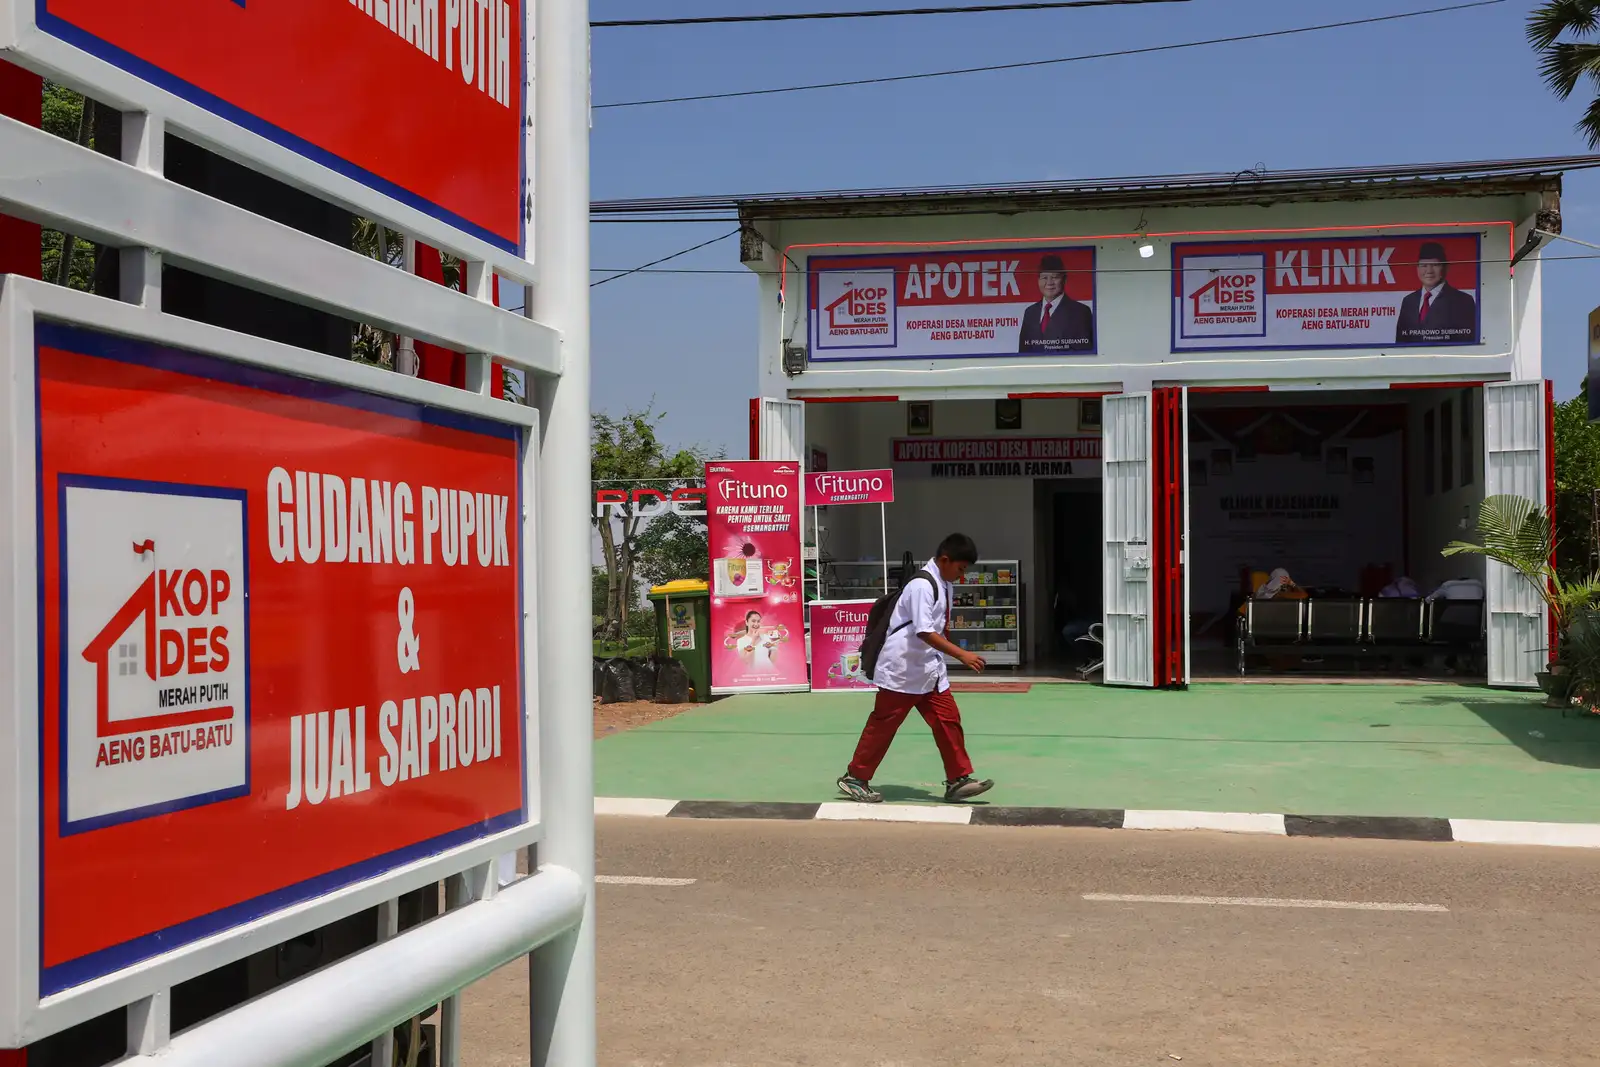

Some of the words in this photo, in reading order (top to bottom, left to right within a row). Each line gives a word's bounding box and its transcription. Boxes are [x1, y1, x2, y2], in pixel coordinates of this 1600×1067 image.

[446, 0, 510, 109] PUTIH
[1275, 247, 1396, 287] KLINIK
[904, 260, 1021, 300] APOTEK
[1220, 275, 1256, 289] KOP
[854, 287, 887, 301] KOP
[1220, 290, 1256, 304] DES
[854, 302, 887, 316] DES
[1276, 308, 1316, 319] KOPERASI
[1317, 307, 1339, 318] DESA
[1340, 307, 1369, 317] MERAH
[1371, 306, 1396, 316] PUTIH
[906, 319, 944, 330] KOPERASI
[945, 319, 966, 329] DESA
[967, 318, 994, 328] MERAH
[995, 317, 1019, 327] PUTIH
[1194, 316, 1214, 325] AENG
[1216, 315, 1256, 324] BATU-BATU
[1302, 320, 1324, 330] AENG
[1326, 319, 1370, 329] BATU-BATU
[829, 327, 848, 336] AENG
[850, 326, 888, 335] BATU-BATU
[930, 330, 952, 341] AENG
[953, 329, 995, 340] BATU-BATU
[899, 442, 940, 460] APOTEK
[943, 441, 998, 459] KOPERASI
[1000, 440, 1030, 458] DESA
[1031, 440, 1071, 457] MERAH
[931, 461, 977, 477] MITRA
[979, 461, 1021, 476] KIMIA
[1024, 460, 1073, 476] FARMA
[725, 480, 788, 499] Fituno
[822, 476, 883, 493] Fituno
[267, 466, 414, 566] GUDANG
[422, 488, 509, 567] PUPUK
[716, 506, 739, 514] KARENA
[740, 505, 758, 514] KAMU
[759, 505, 784, 514] TERLALU
[728, 515, 752, 524] PENTING
[753, 514, 773, 523] UNTUK
[774, 514, 791, 523] SAKIT
[159, 568, 231, 618] KOP
[839, 610, 869, 622] Fitun
[398, 586, 420, 674] &
[823, 626, 843, 635] KARENA
[833, 634, 855, 642] PENTING
[159, 625, 230, 678] DES
[158, 686, 197, 709] MERAH
[199, 682, 229, 705] PUTIH
[96, 737, 145, 768] AENG
[150, 723, 233, 759] BATU-BATU
[286, 705, 371, 810] JUAL
[379, 686, 502, 787] SAPRODI
